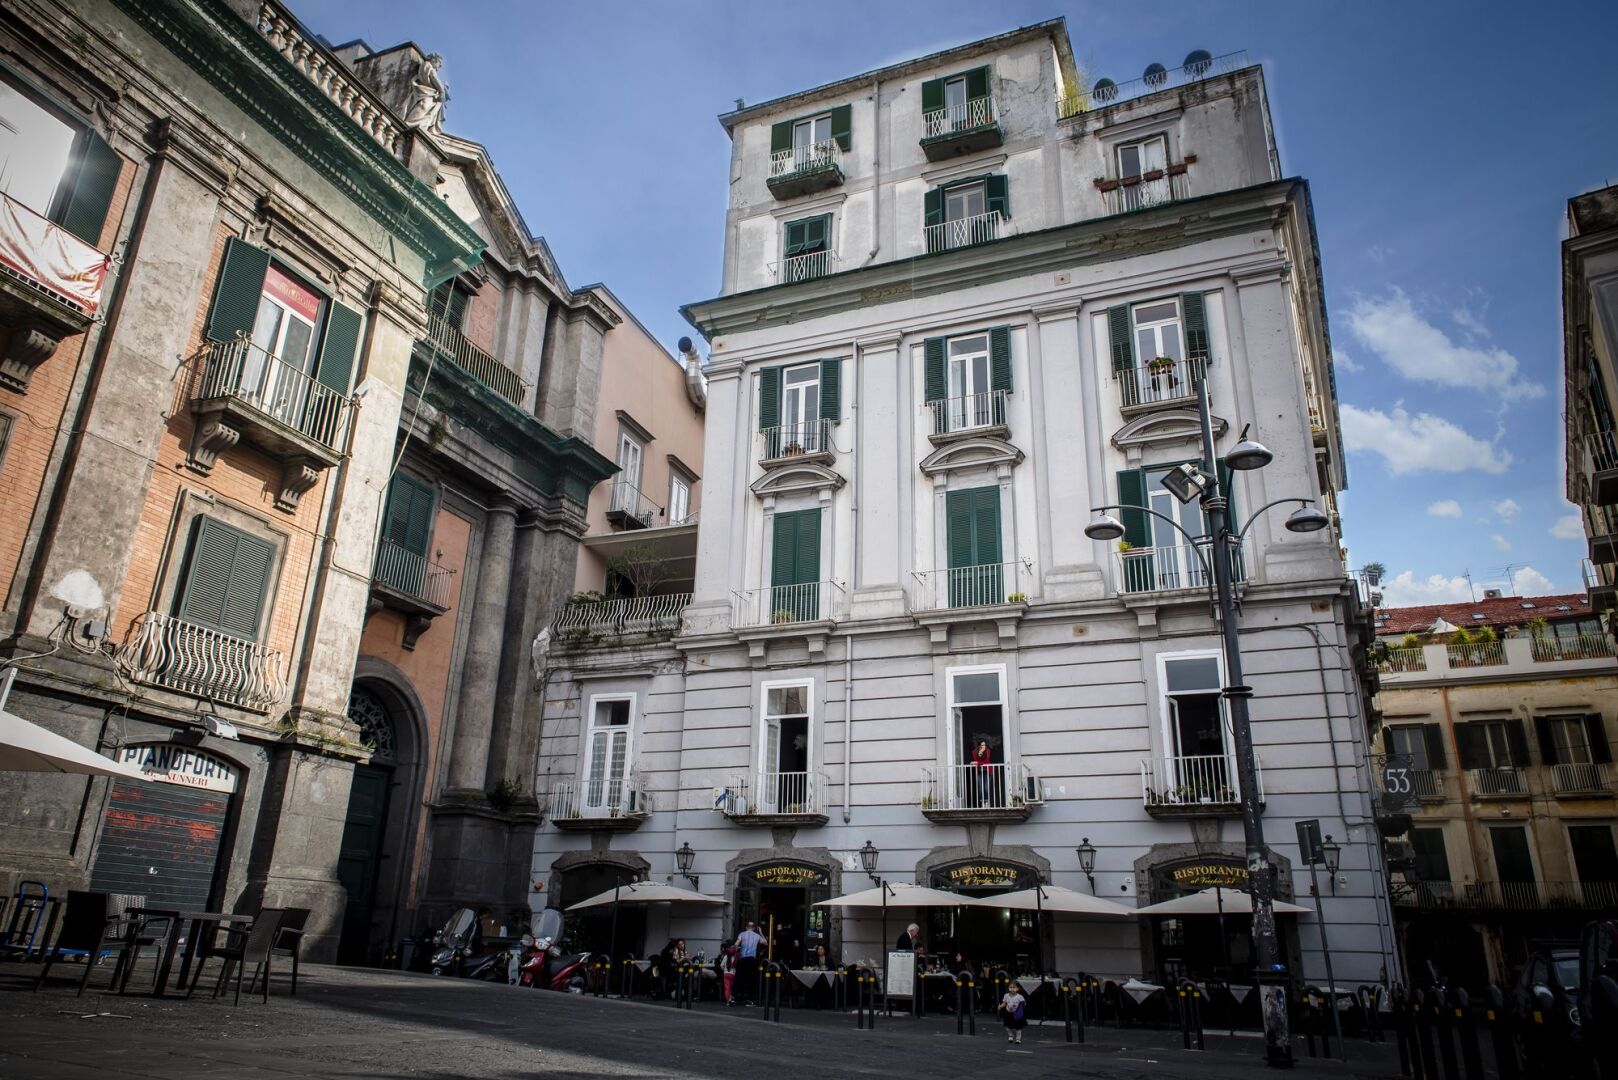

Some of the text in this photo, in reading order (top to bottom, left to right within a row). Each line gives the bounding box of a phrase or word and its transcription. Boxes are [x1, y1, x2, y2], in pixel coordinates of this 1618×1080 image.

[124, 745, 230, 780] PIANOFORTI
[1387, 768, 1410, 793] 53
[756, 866, 815, 879] RISTORANTE
[950, 866, 1017, 879] RISTORANTE
[1173, 866, 1249, 880] RISTORANTE
